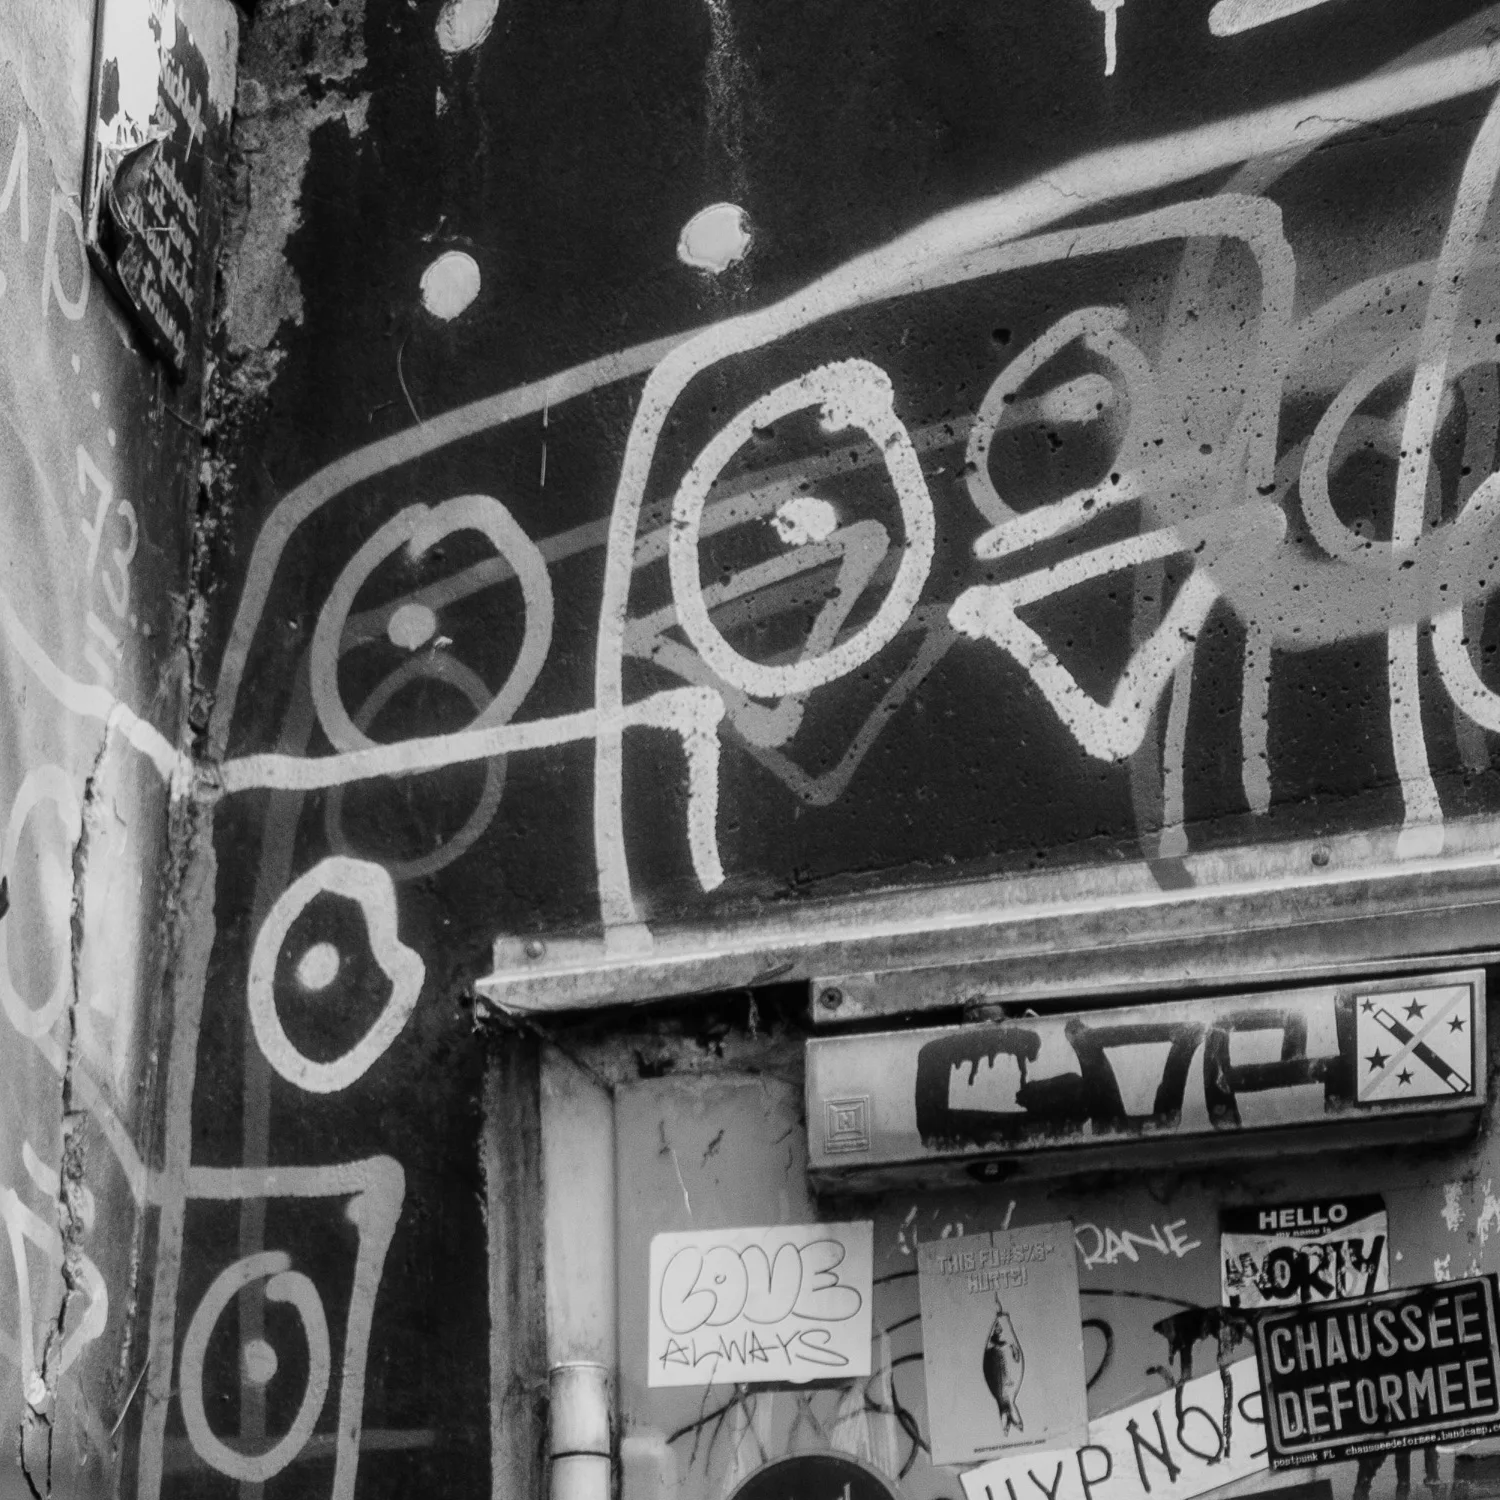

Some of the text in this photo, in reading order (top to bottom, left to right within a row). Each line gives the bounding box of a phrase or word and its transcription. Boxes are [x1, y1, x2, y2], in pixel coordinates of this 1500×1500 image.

[1259, 1204, 1348, 1230] HELLO
[659, 1328, 850, 1370] ALWAYS
[1270, 1291, 1483, 1375] CHAUSSEE
[1278, 1358, 1494, 1440] DEFORMEE
